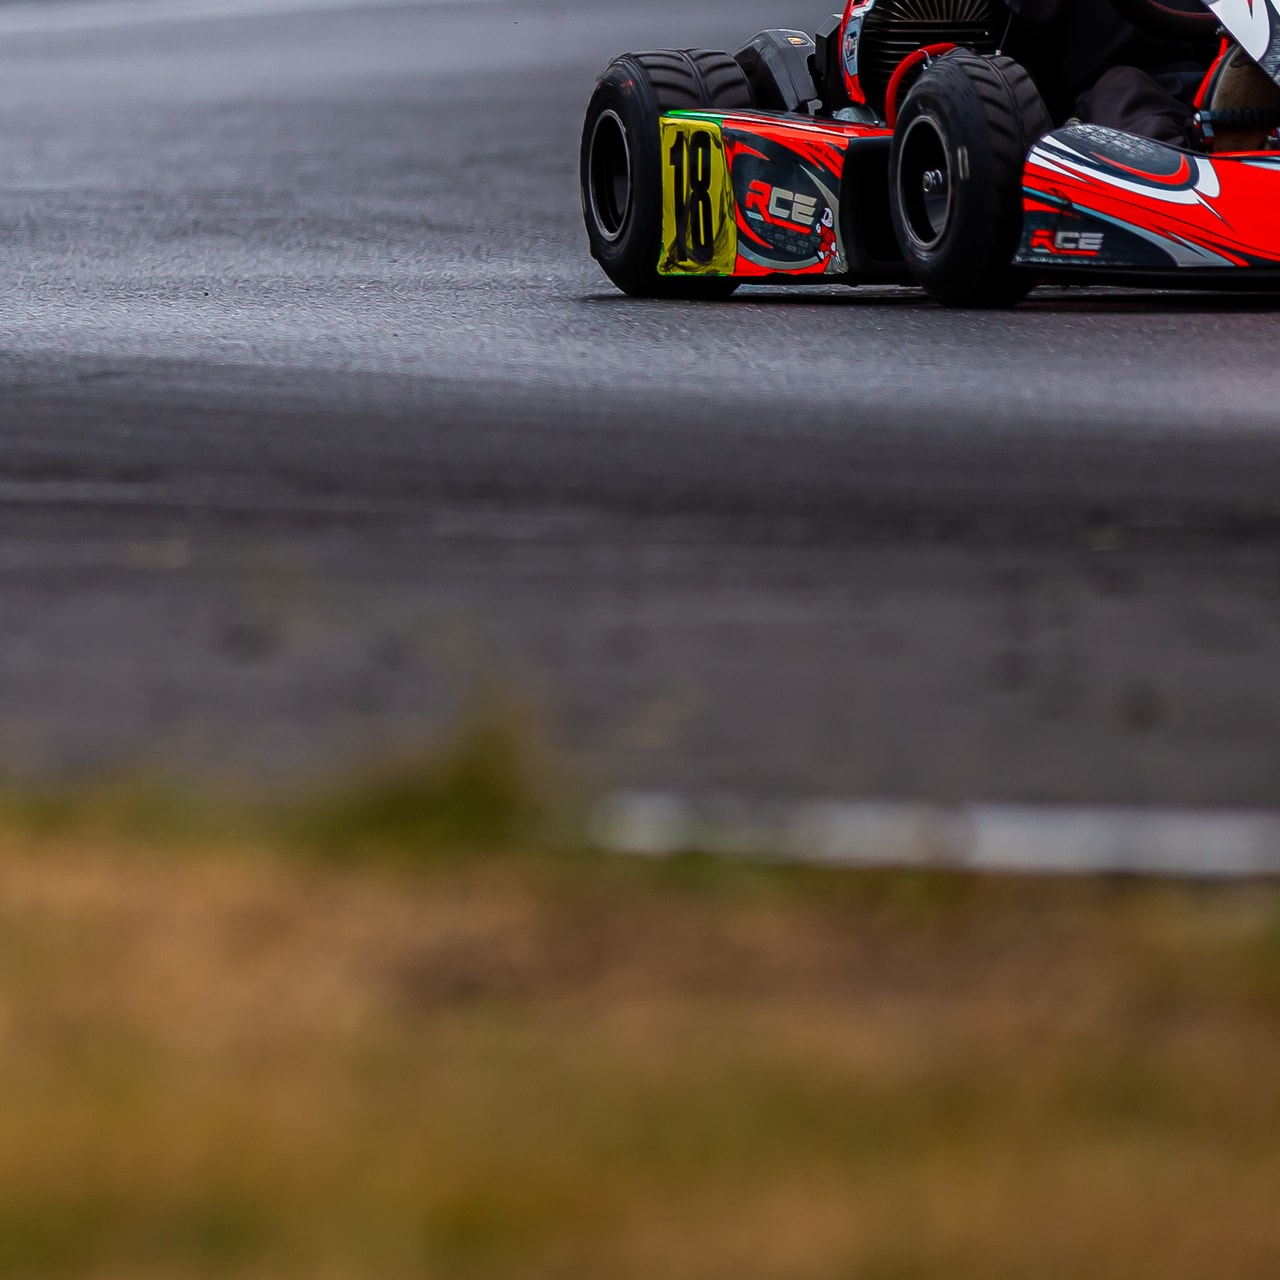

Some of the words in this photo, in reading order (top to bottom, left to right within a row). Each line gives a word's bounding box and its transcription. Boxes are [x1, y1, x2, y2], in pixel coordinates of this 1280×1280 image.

[669, 130, 715, 265] 18
[744, 179, 818, 234] RCE
[1030, 229, 1105, 256] RCE
